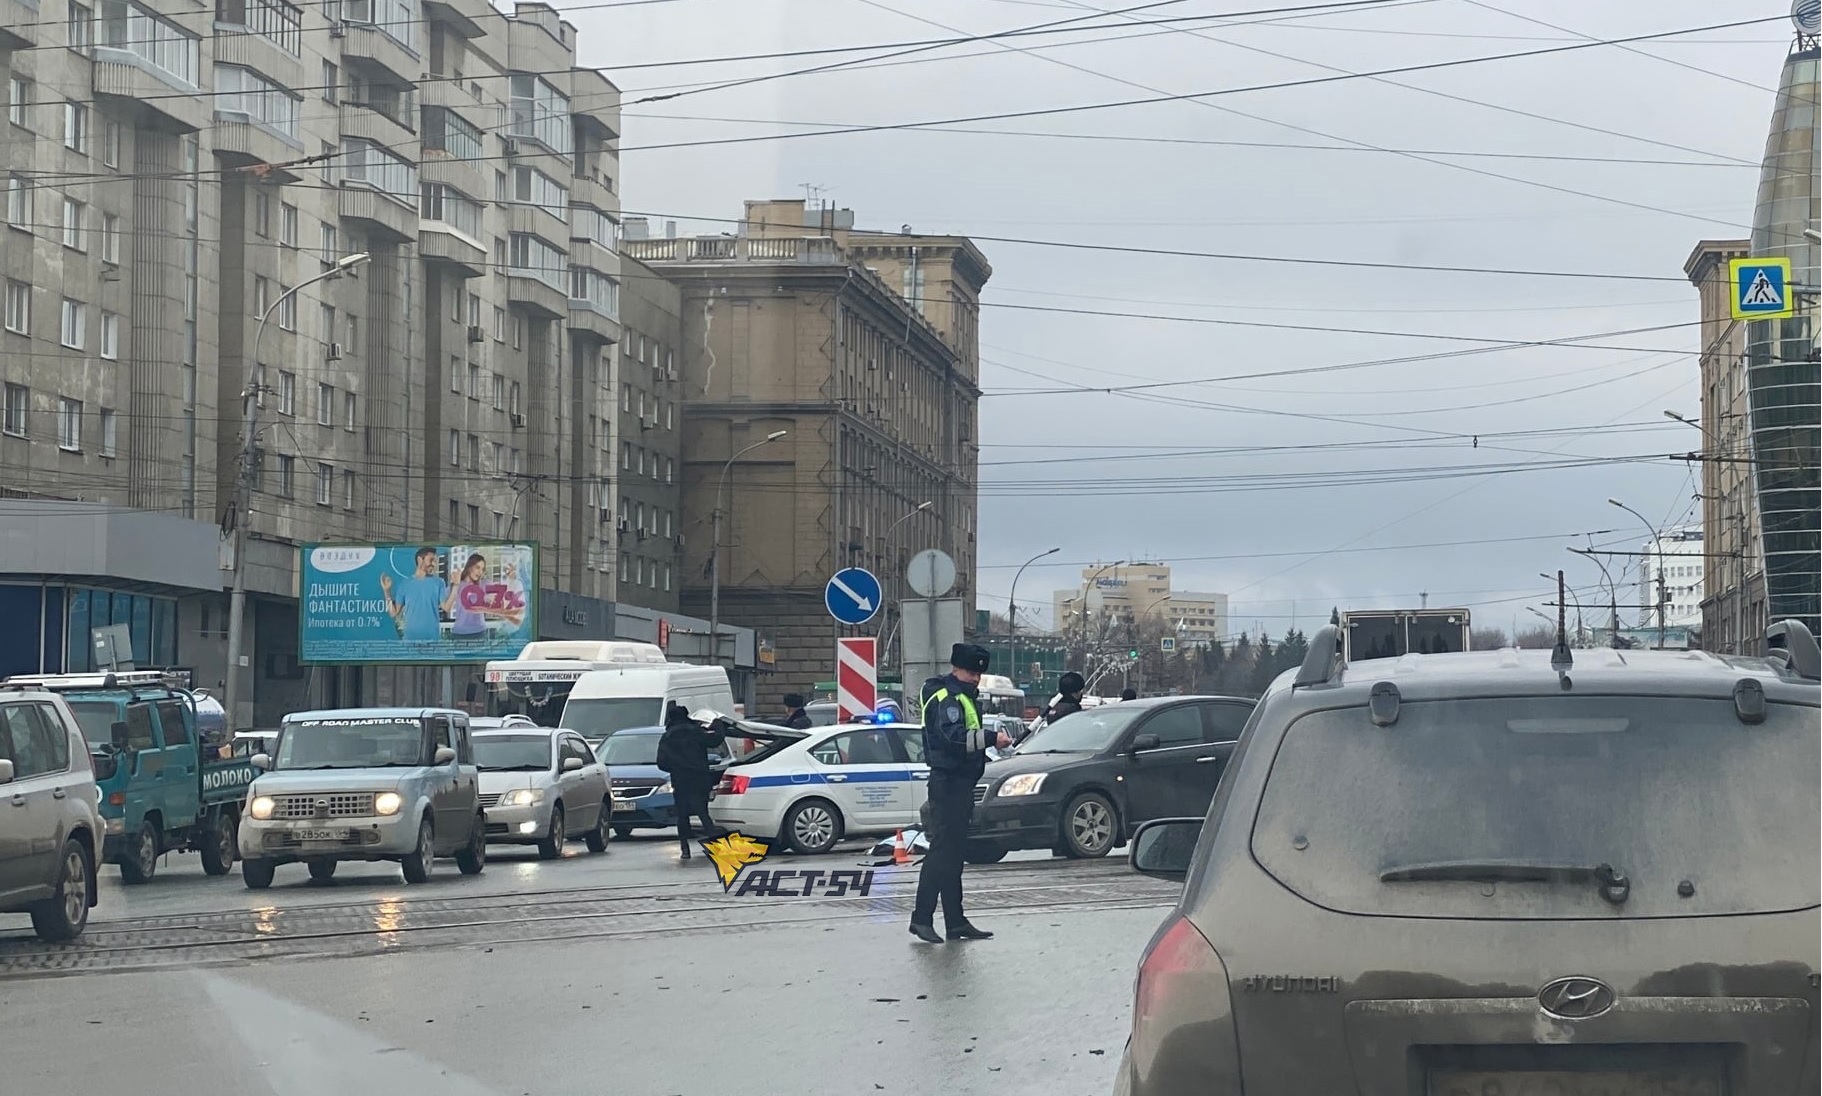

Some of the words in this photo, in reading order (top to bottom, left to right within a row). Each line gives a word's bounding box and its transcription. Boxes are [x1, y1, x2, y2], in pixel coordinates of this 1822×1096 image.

[309, 583, 360, 597] ДЫШИТЕ
[308, 617, 344, 628] Ипотека
[347, 619, 355, 628] от
[203, 768, 252, 790] МОЛОКО
[1243, 975, 1339, 993] HYUNDAI
